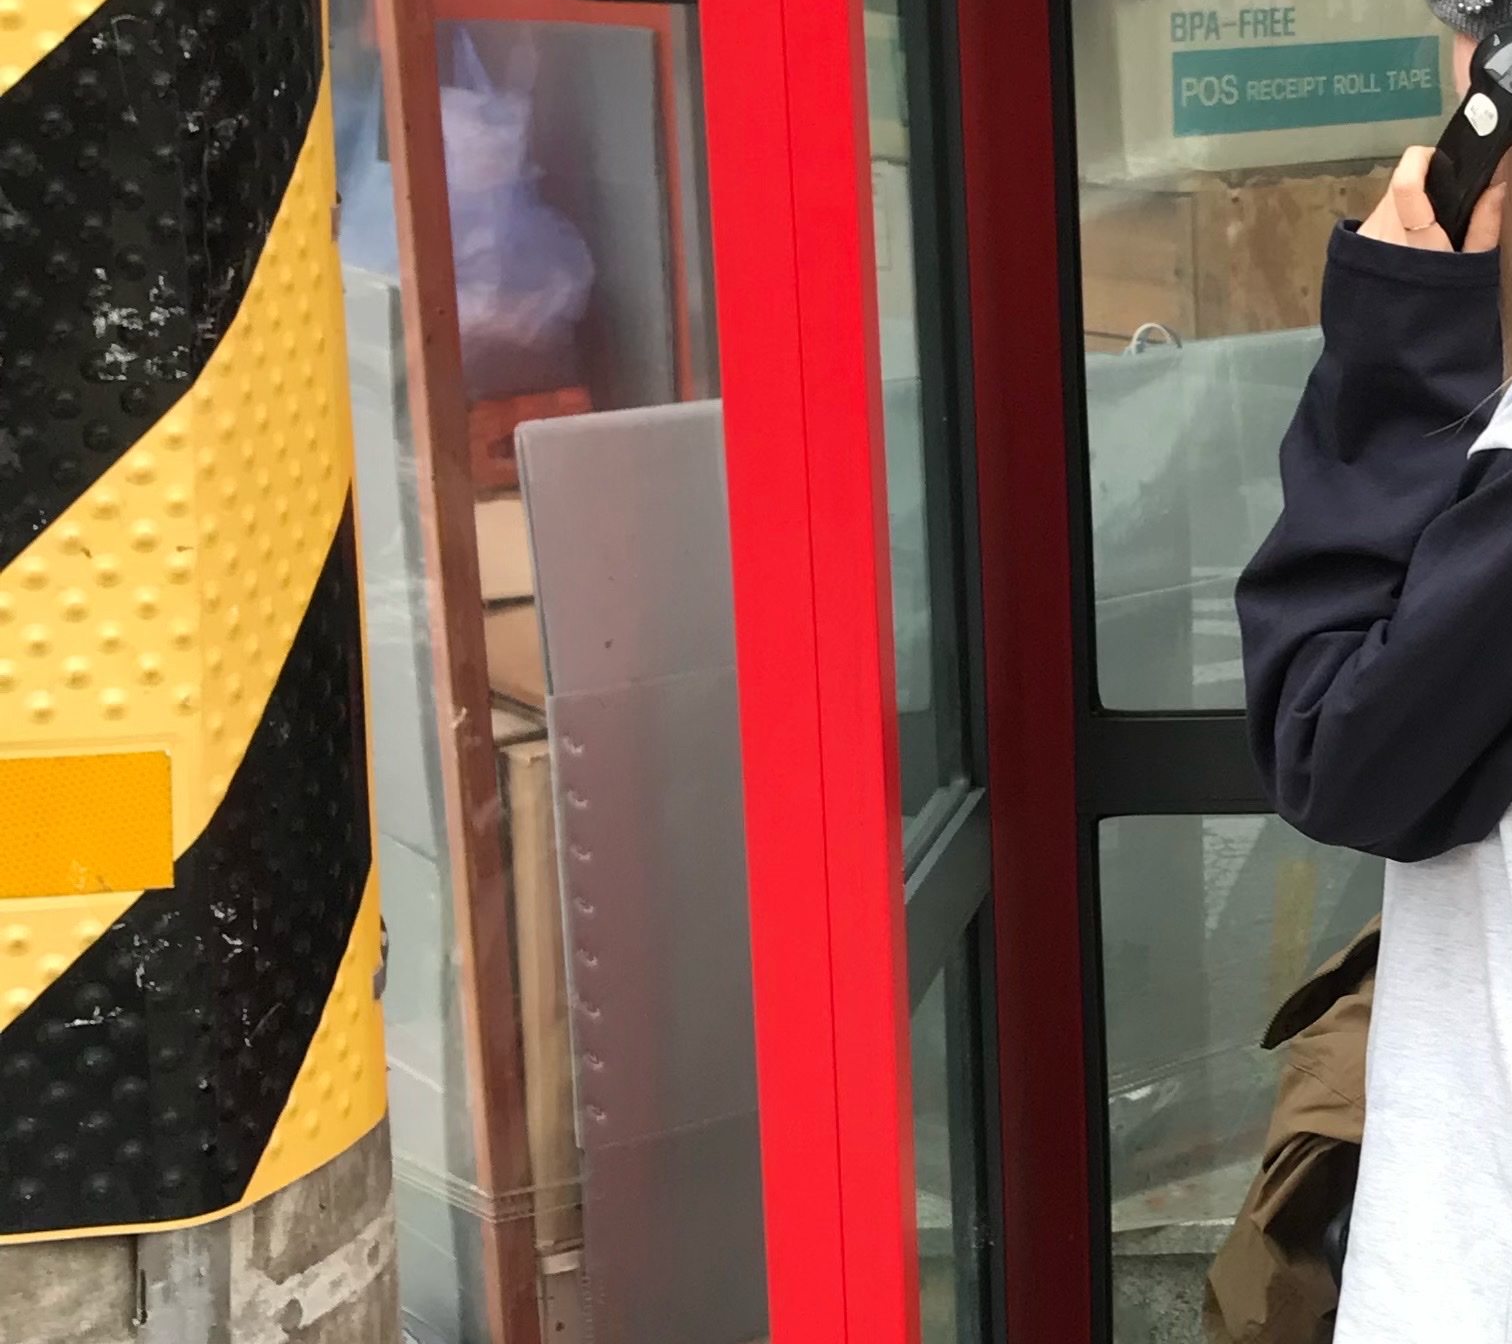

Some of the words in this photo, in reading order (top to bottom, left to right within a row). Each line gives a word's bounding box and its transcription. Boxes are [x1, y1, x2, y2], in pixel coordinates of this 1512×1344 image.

[1171, 7, 1296, 43] BPA-FREE
[1181, 74, 1239, 107] POS
[1246, 76, 1327, 102] RECEIPT
[1333, 72, 1381, 94] ROLL
[1386, 67, 1432, 92] TAPE
